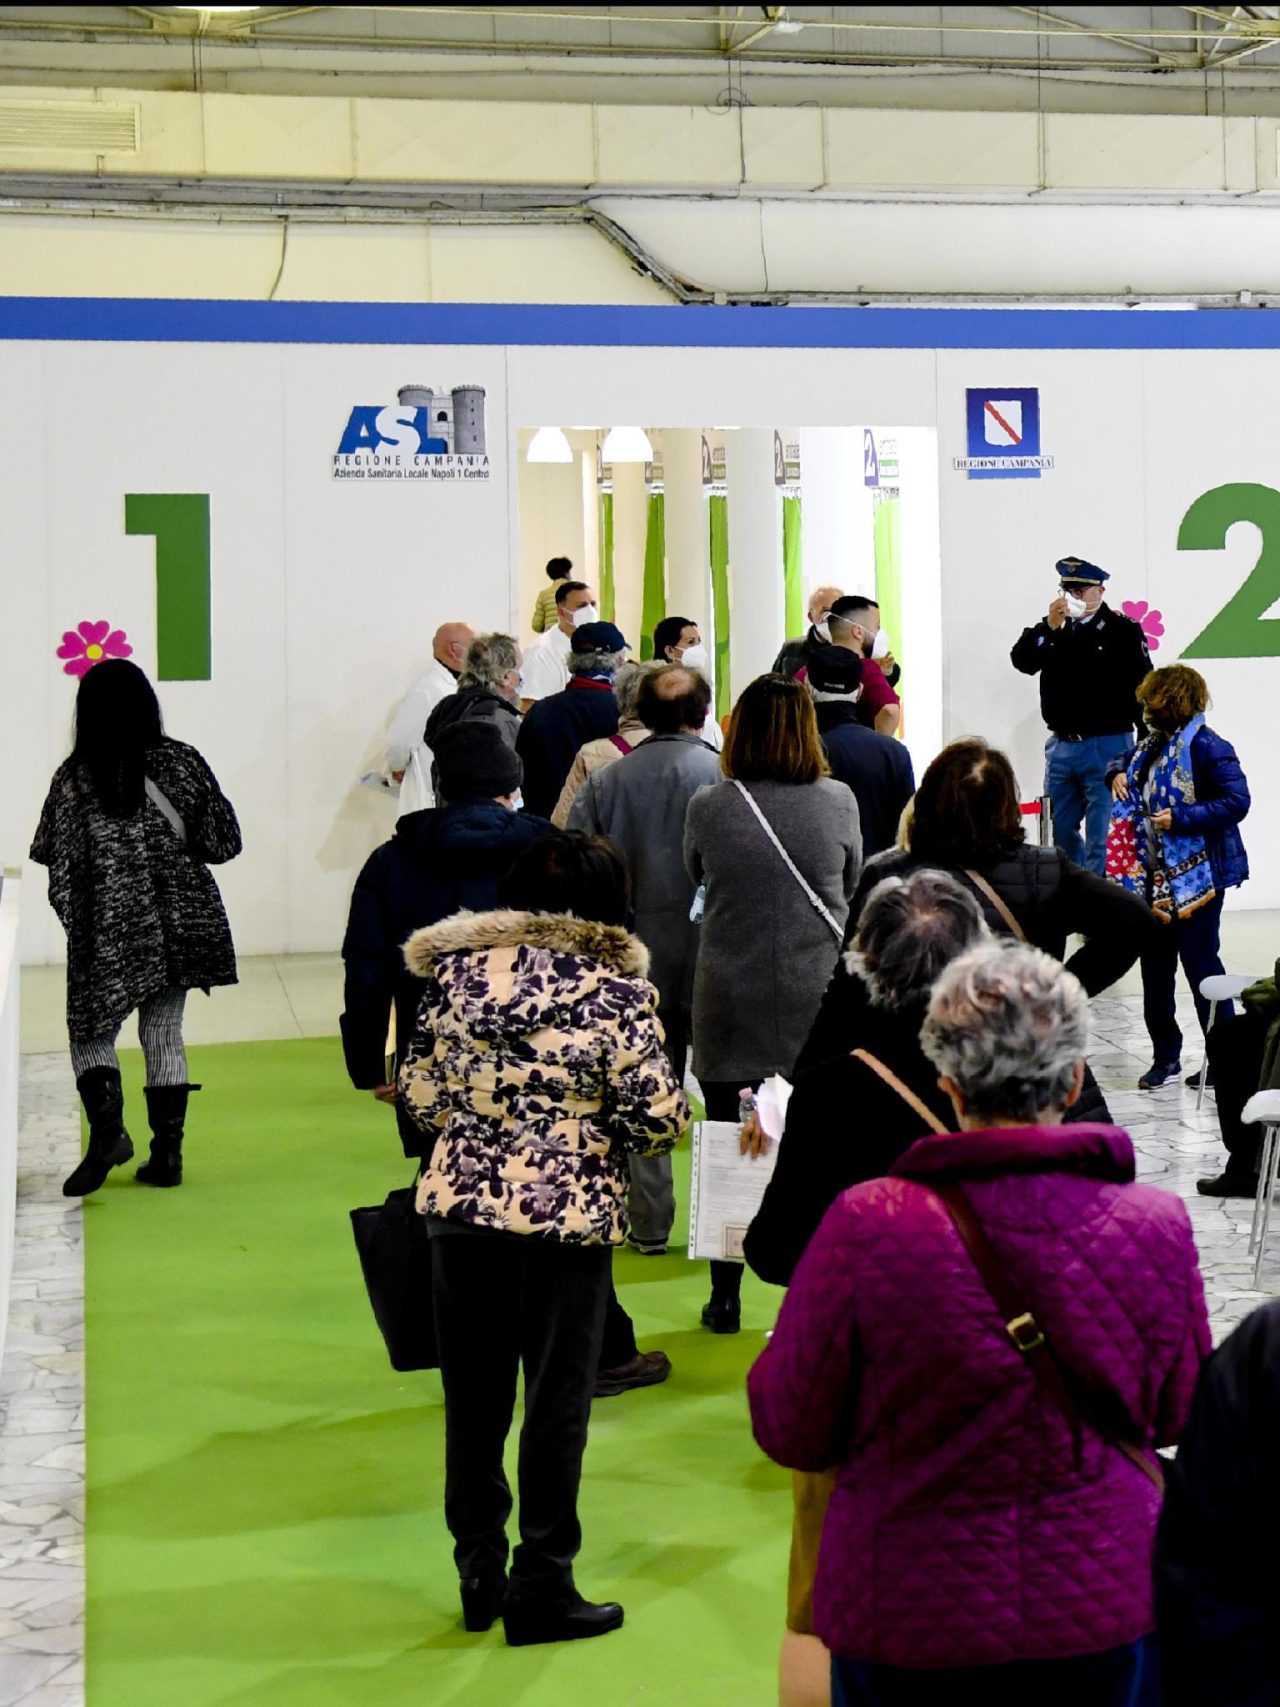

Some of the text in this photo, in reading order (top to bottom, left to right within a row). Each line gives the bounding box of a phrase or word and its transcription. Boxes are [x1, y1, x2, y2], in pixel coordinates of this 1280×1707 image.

[337, 405, 449, 455] ASL
[333, 455, 490, 466] REGIONE CAMPANIA
[956, 458, 1052, 469] REGIONE CAMPANIA
[334, 469, 366, 479] Azienda
[367, 468, 403, 479] Sanitaria
[404, 468, 429, 479] Locale
[431, 469, 456, 481] Napoli
[463, 469, 490, 479] Centro
[125, 493, 211, 681] 1
